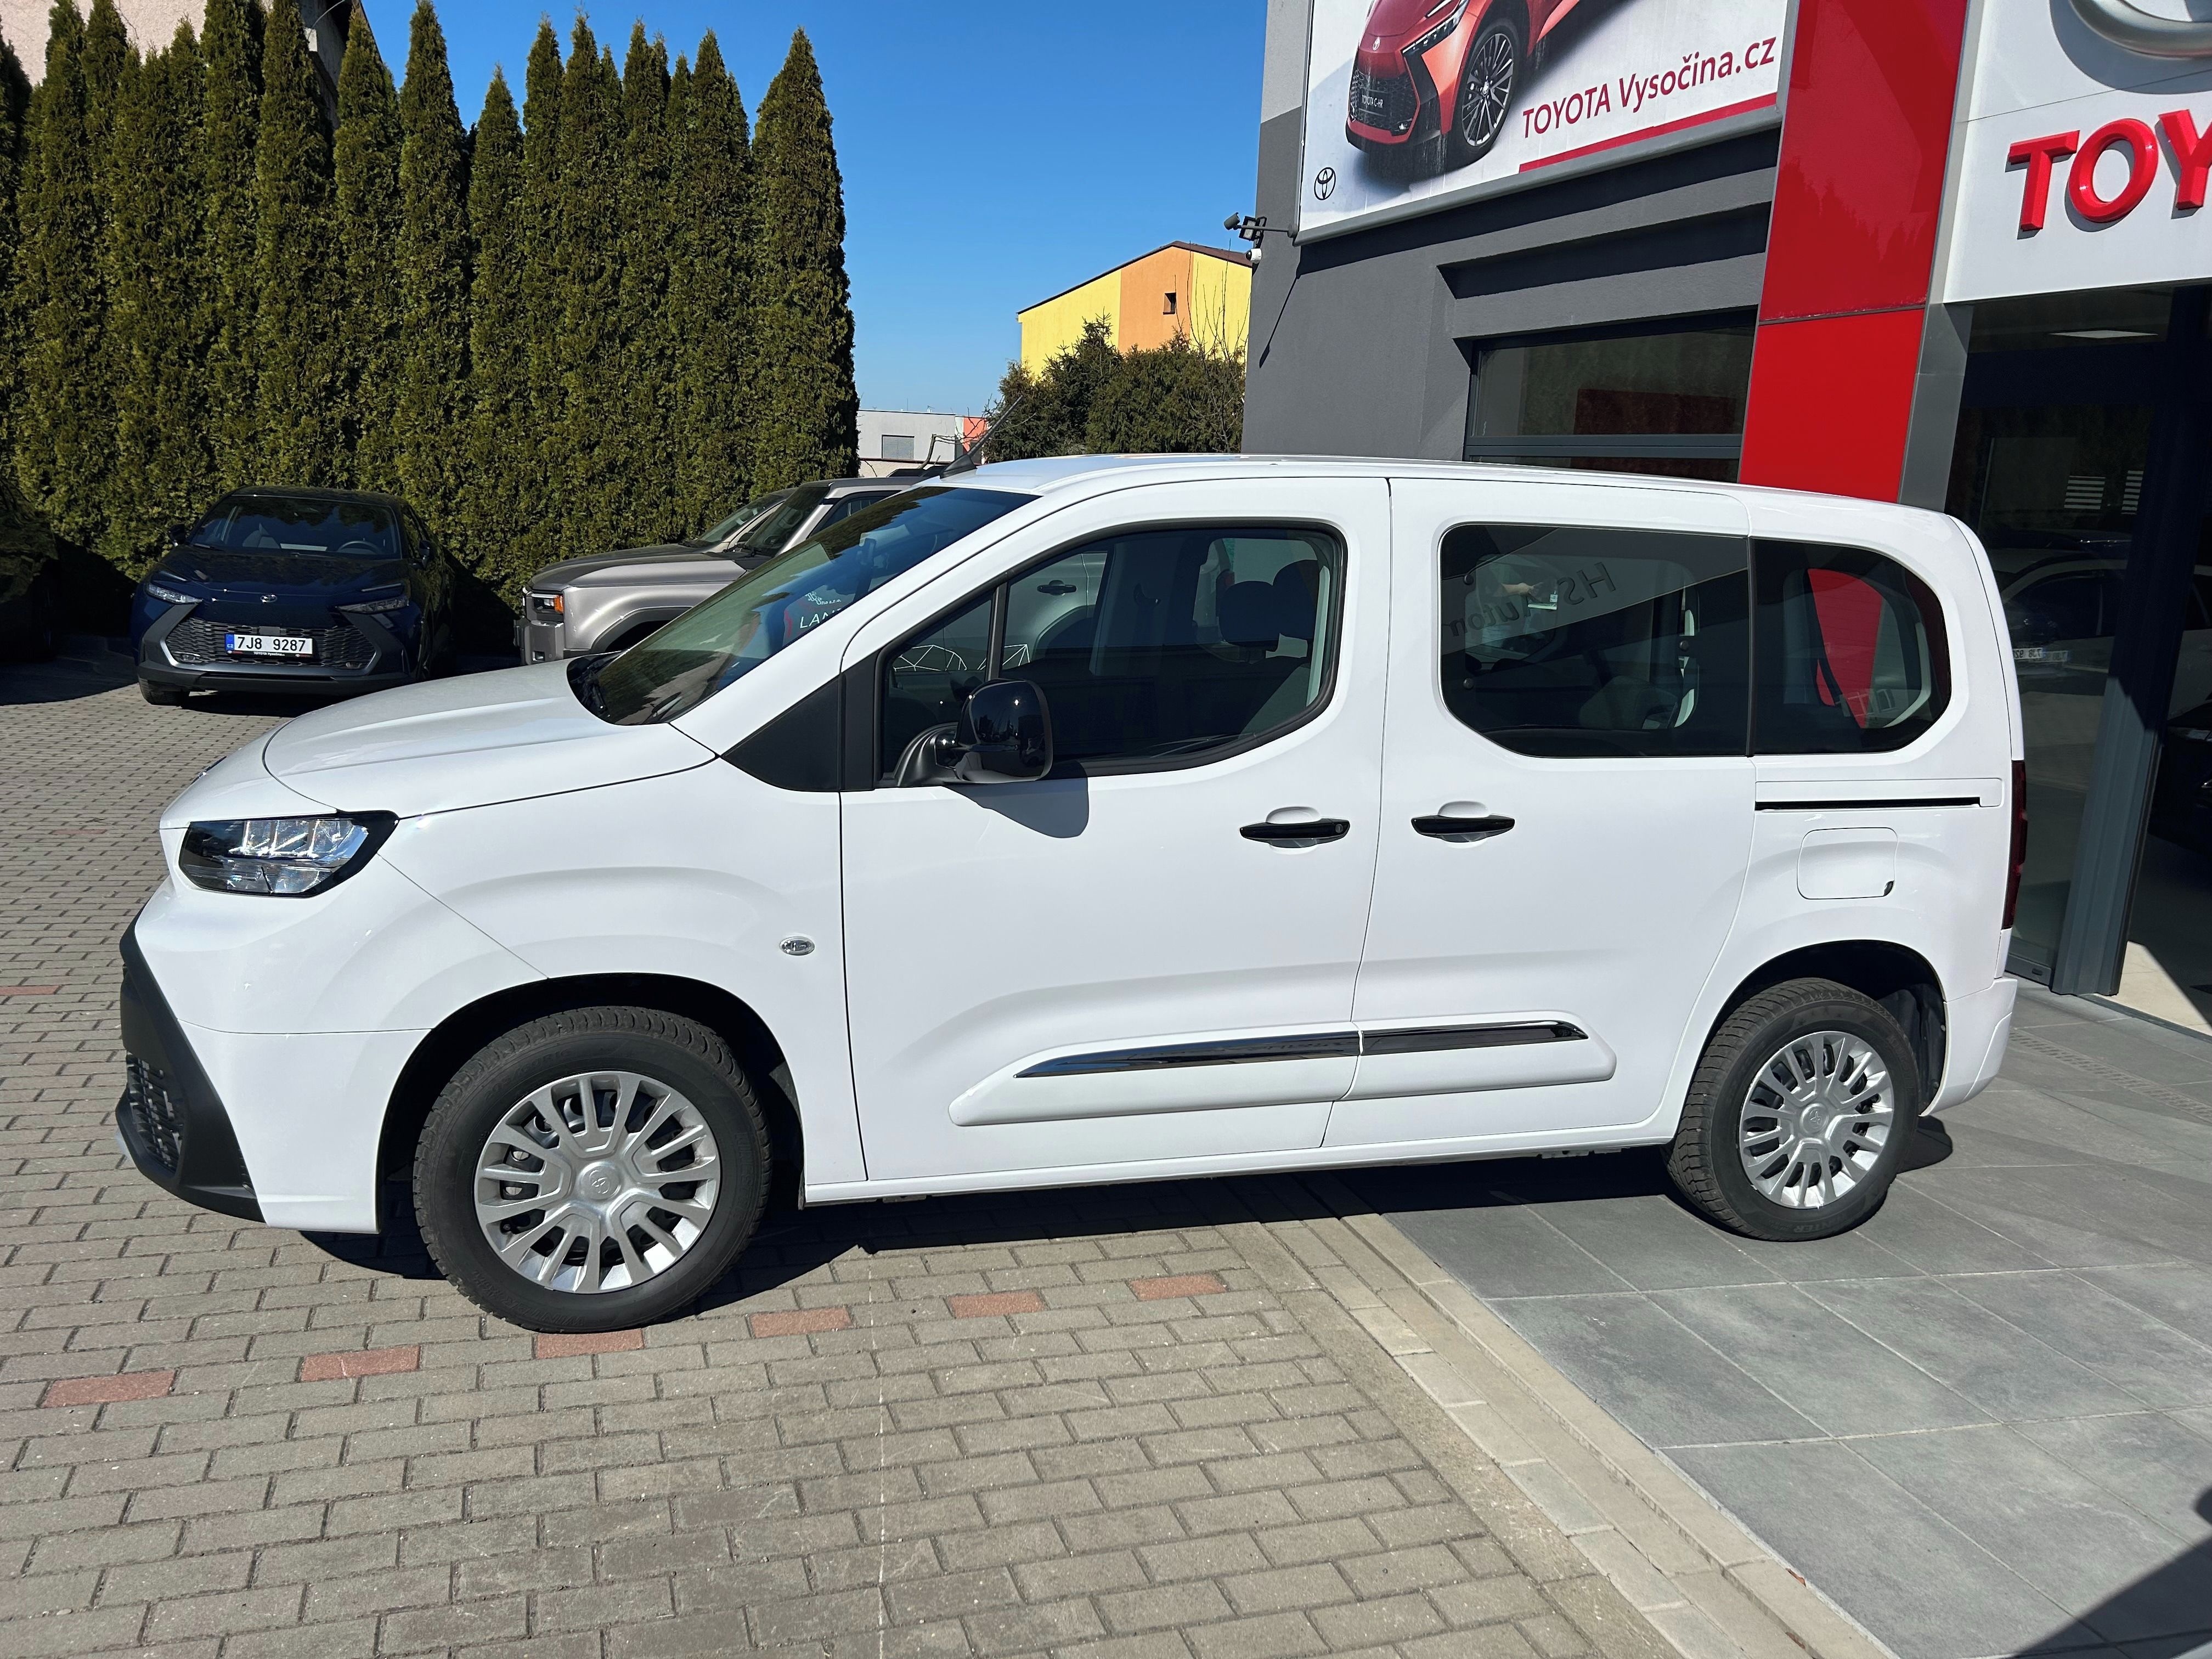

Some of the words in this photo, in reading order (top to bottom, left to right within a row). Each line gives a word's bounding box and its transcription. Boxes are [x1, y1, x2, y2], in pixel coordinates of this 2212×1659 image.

[1522, 83, 1611, 138] TOYOTA
[1618, 36, 1776, 113] Vysočina.cz
[238, 636, 262, 650] 7J8
[273, 639, 306, 652] 9287
